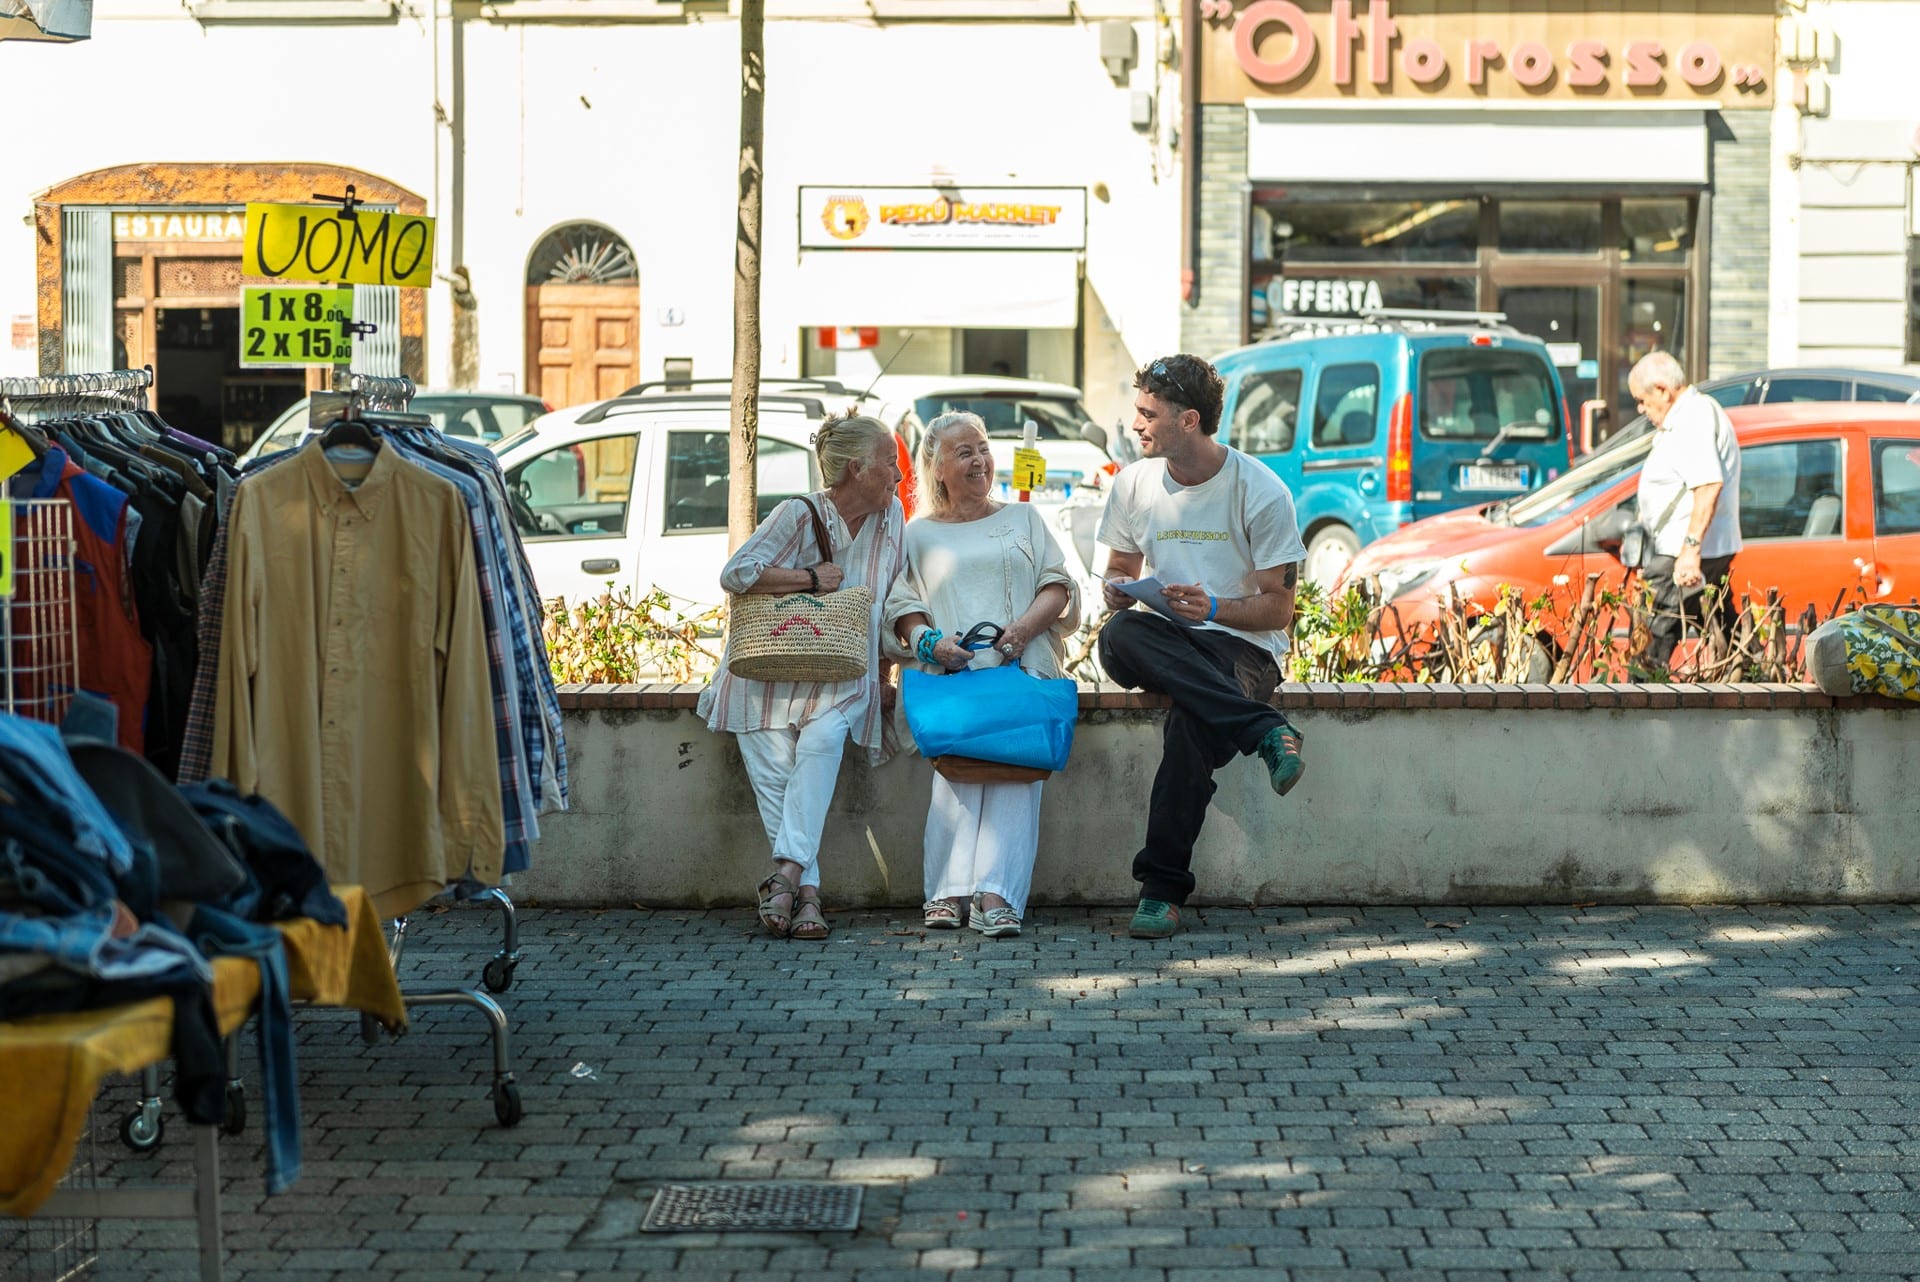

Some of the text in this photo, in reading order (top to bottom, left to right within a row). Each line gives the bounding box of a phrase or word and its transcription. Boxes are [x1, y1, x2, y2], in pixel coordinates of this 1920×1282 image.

[114, 213, 248, 237] ESTAURA
[953, 202, 1062, 225] MARKET
[257, 212, 428, 285] UOMO
[258, 292, 271, 321] 1
[1267, 279, 1383, 313] OFFERTA
[247, 327, 266, 357] 2
